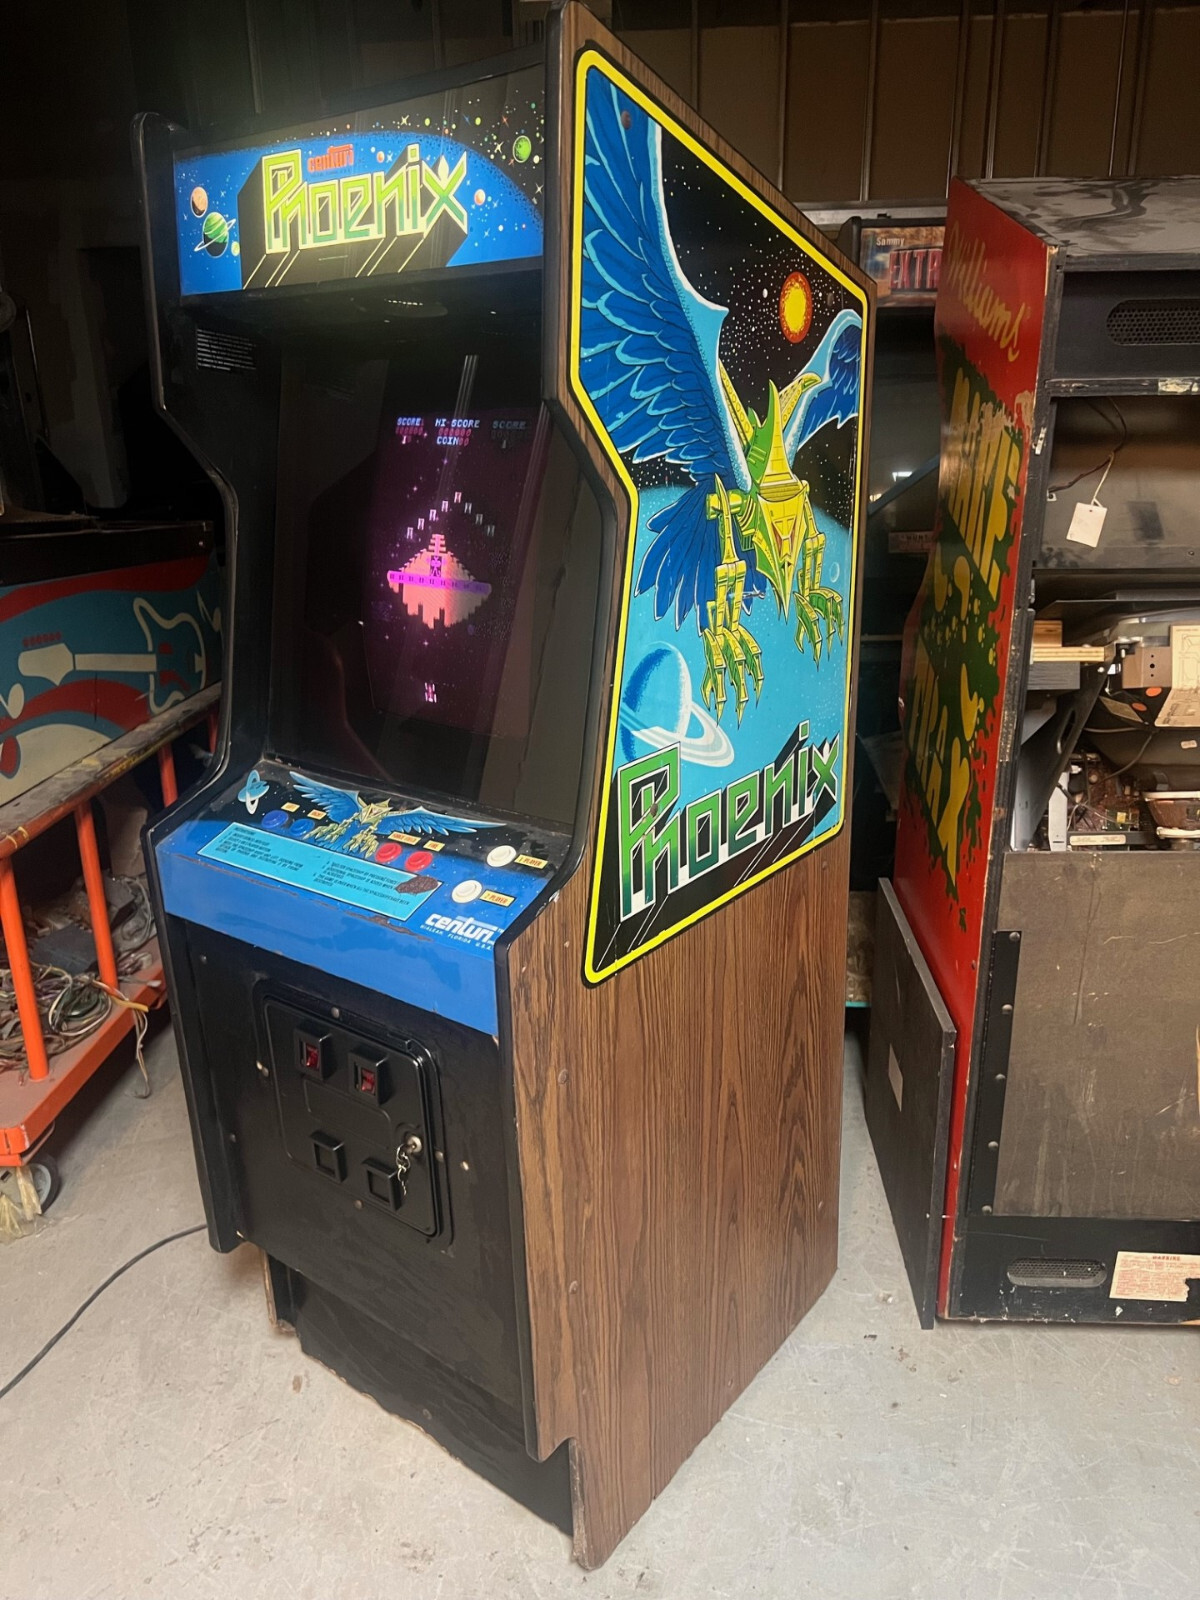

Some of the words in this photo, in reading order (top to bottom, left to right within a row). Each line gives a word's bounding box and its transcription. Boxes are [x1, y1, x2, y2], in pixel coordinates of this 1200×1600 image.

[262, 143, 468, 254] Phoenix
[876, 237, 905, 248] Sammy
[617, 719, 840, 923] Phoenix
